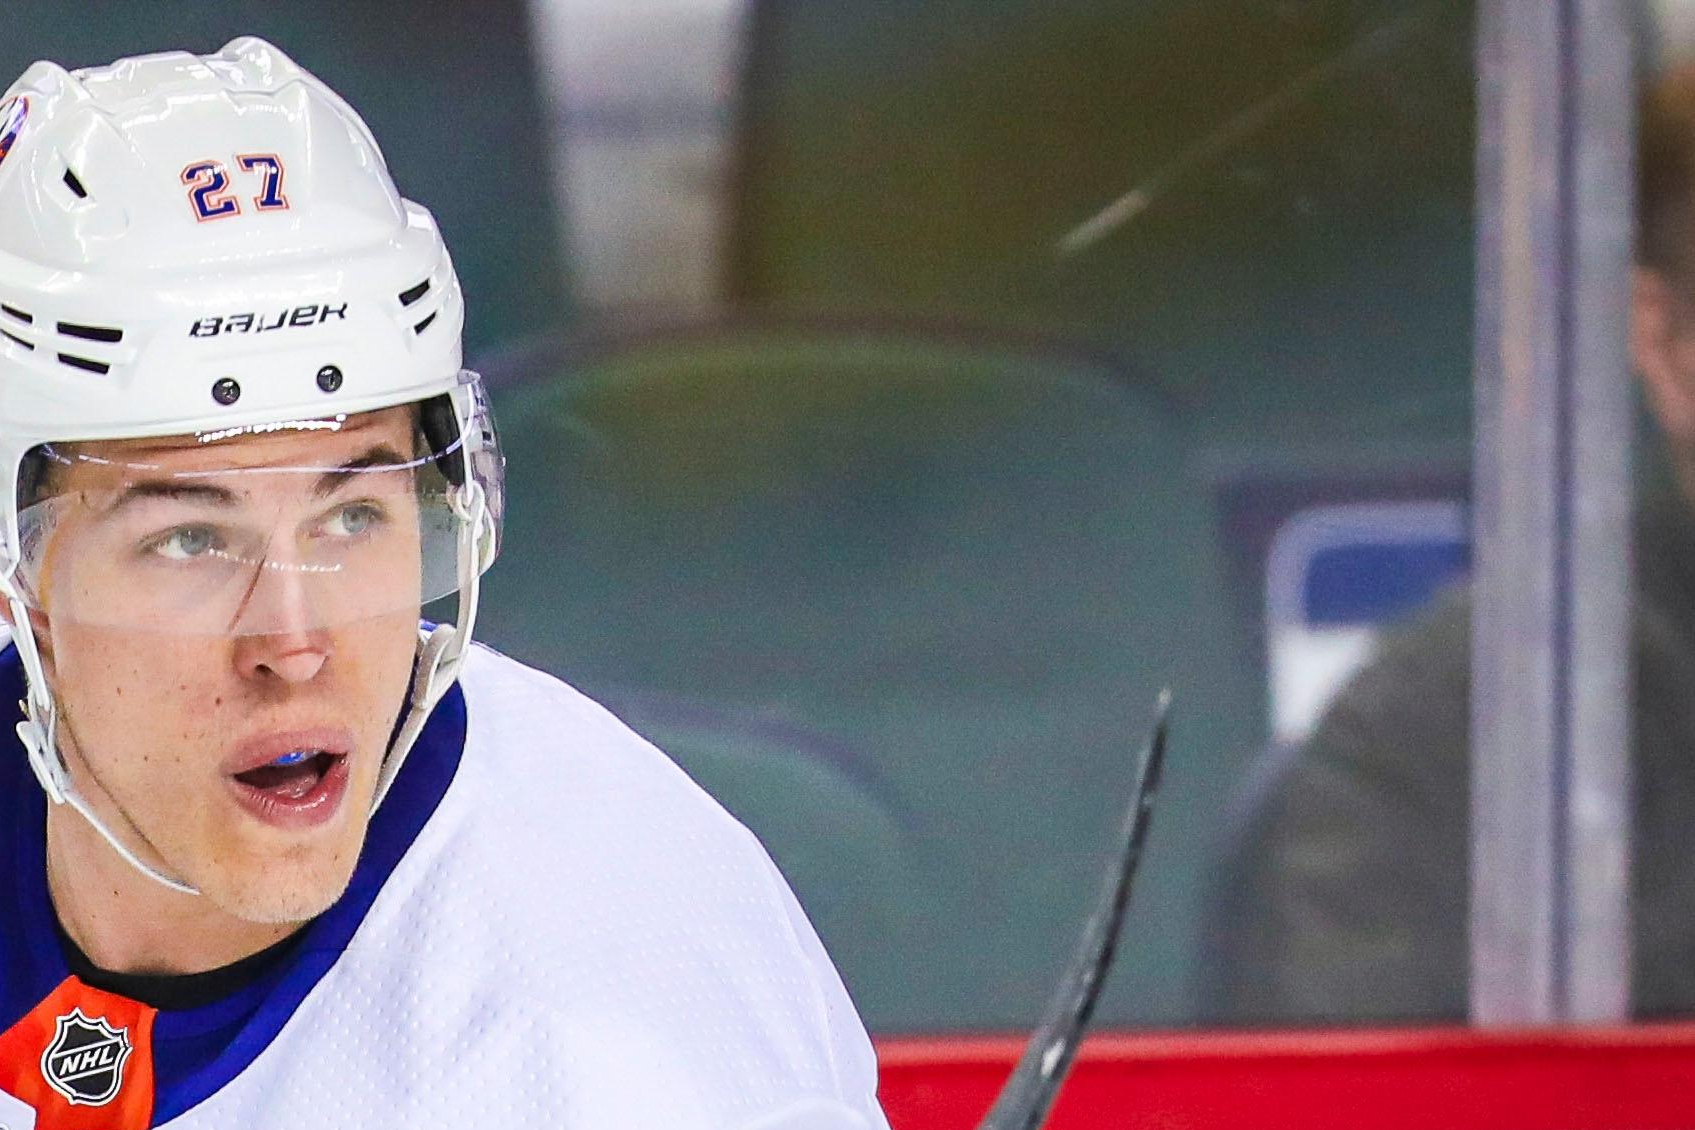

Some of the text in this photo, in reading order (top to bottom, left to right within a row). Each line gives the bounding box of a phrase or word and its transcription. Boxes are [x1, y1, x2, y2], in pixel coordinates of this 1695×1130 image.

[181, 153, 290, 223] 27
[188, 301, 349, 338] BAUER
[58, 1045, 114, 1076] NHL
